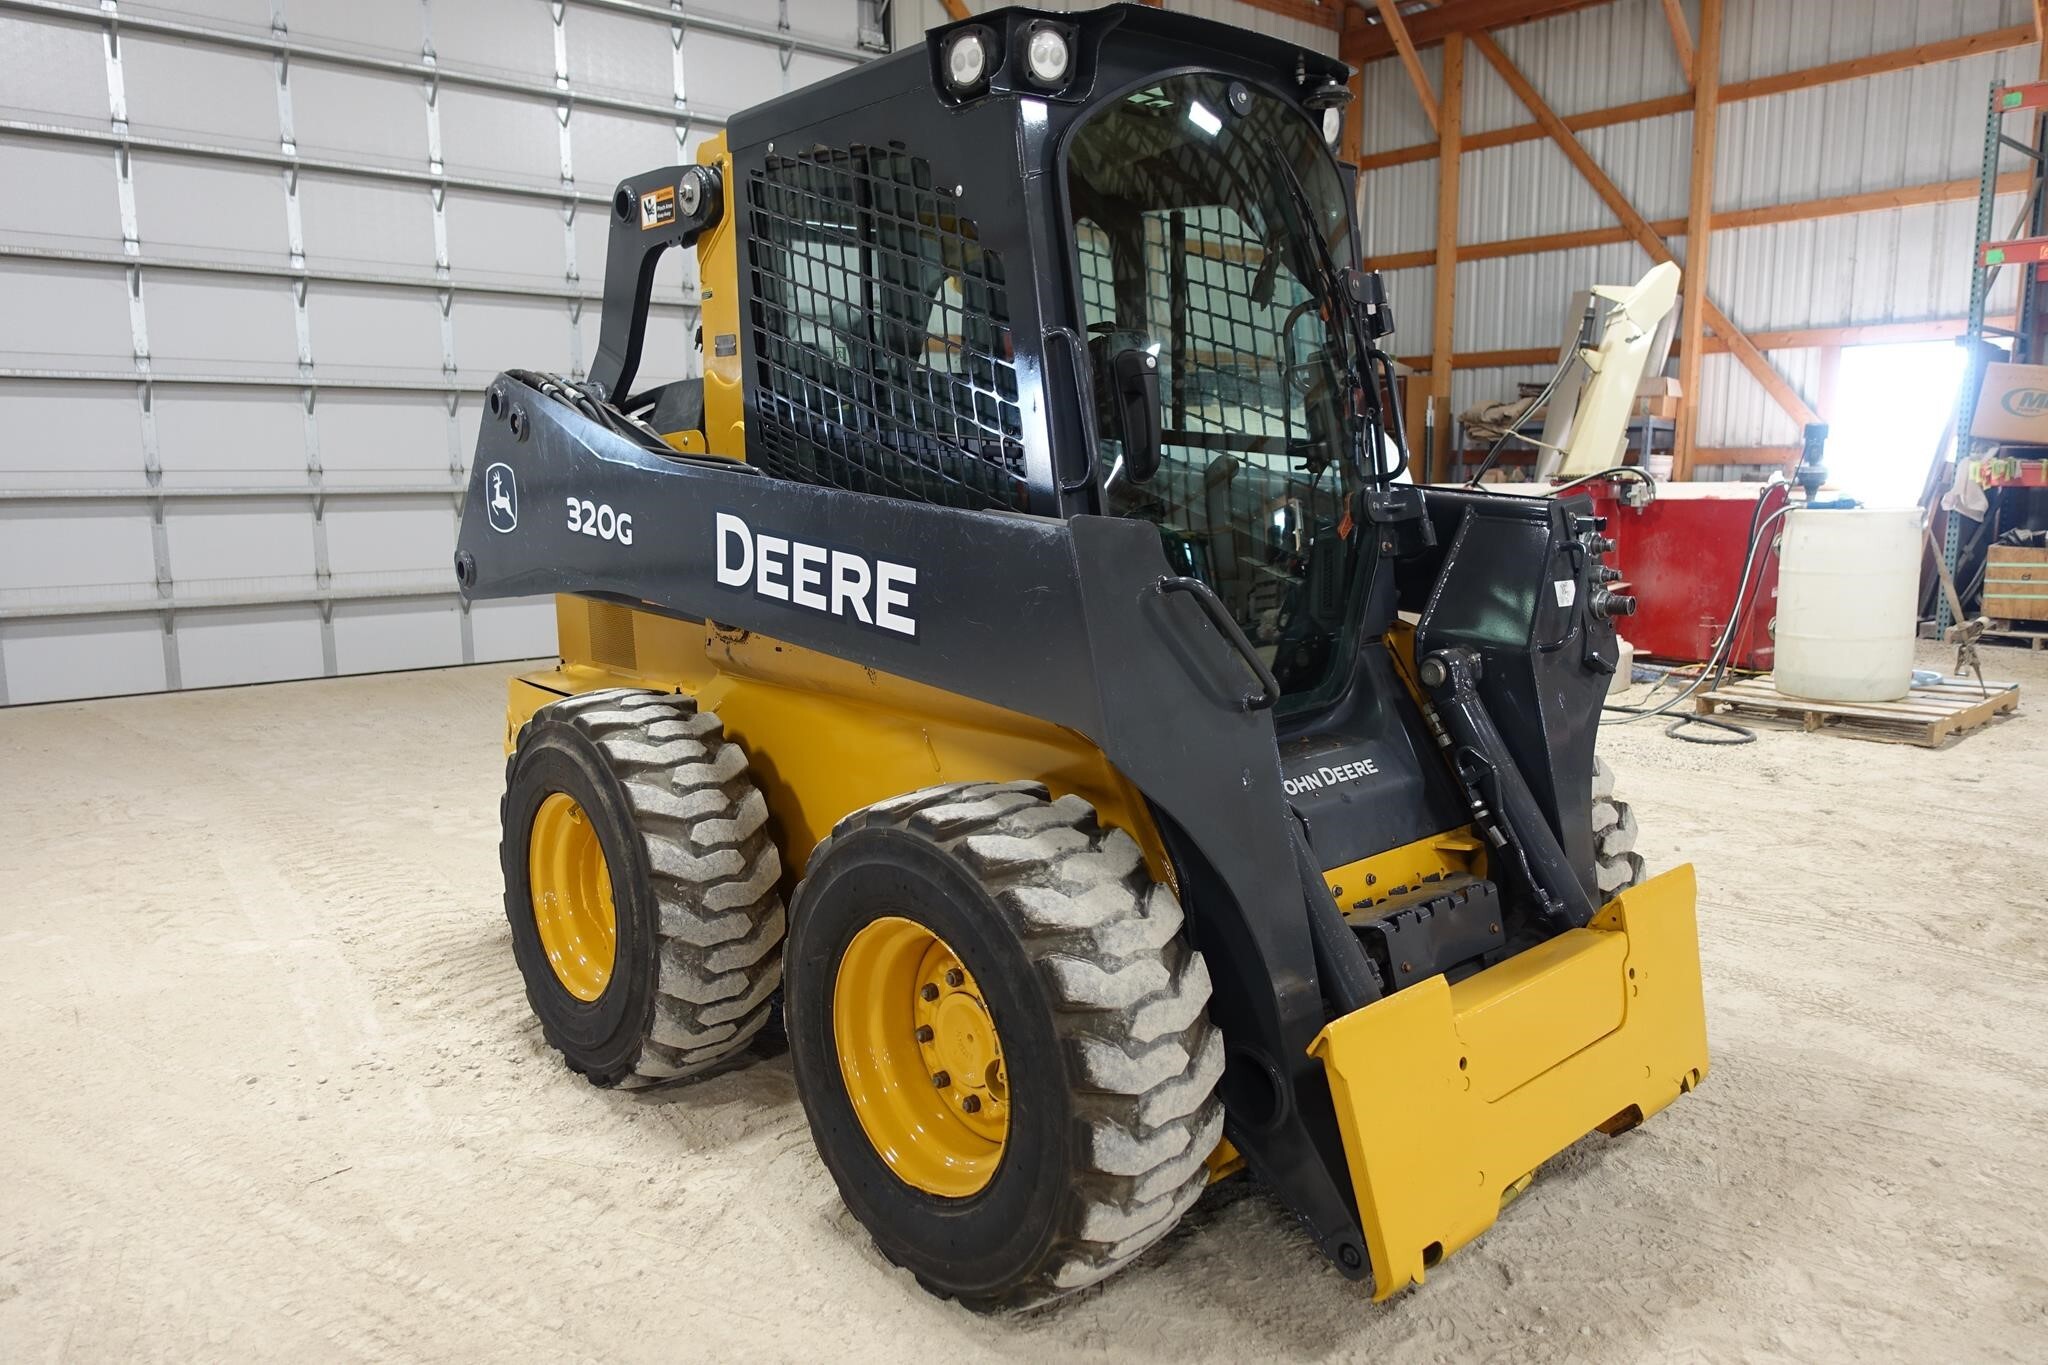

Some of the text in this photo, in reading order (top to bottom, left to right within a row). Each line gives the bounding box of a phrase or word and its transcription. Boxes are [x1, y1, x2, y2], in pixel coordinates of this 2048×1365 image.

[566, 496, 633, 546] 320G
[716, 511, 917, 636] DEERE
[1283, 758, 1379, 796] OHN DEERE
